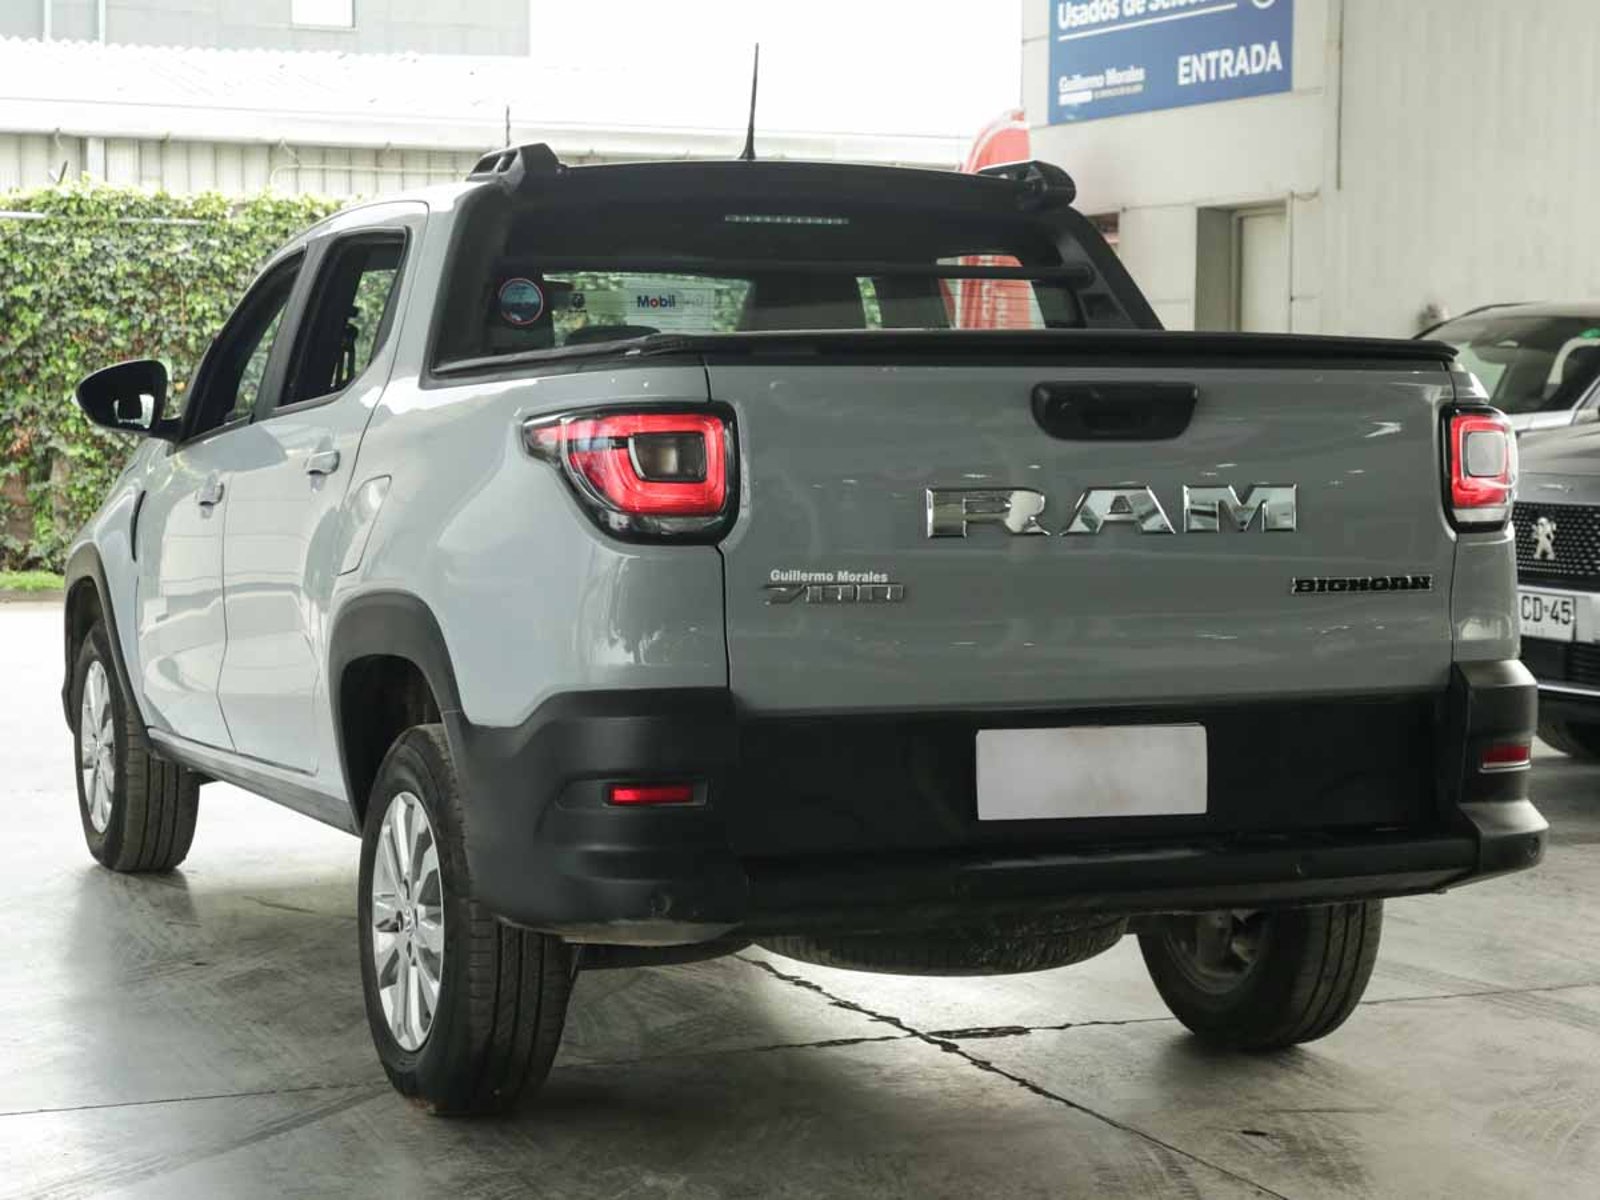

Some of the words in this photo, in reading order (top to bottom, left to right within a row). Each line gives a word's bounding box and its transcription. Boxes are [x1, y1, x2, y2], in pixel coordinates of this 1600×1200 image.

[1058, 0, 1120, 29] Usados
[1177, 41, 1283, 85] ENTRADA
[637, 294, 676, 308] Mobil
[926, 484, 1297, 539] RAM
[770, 569, 835, 582] Guillermo
[837, 570, 889, 583] Morales
[1292, 575, 1432, 594] BIGHORN
